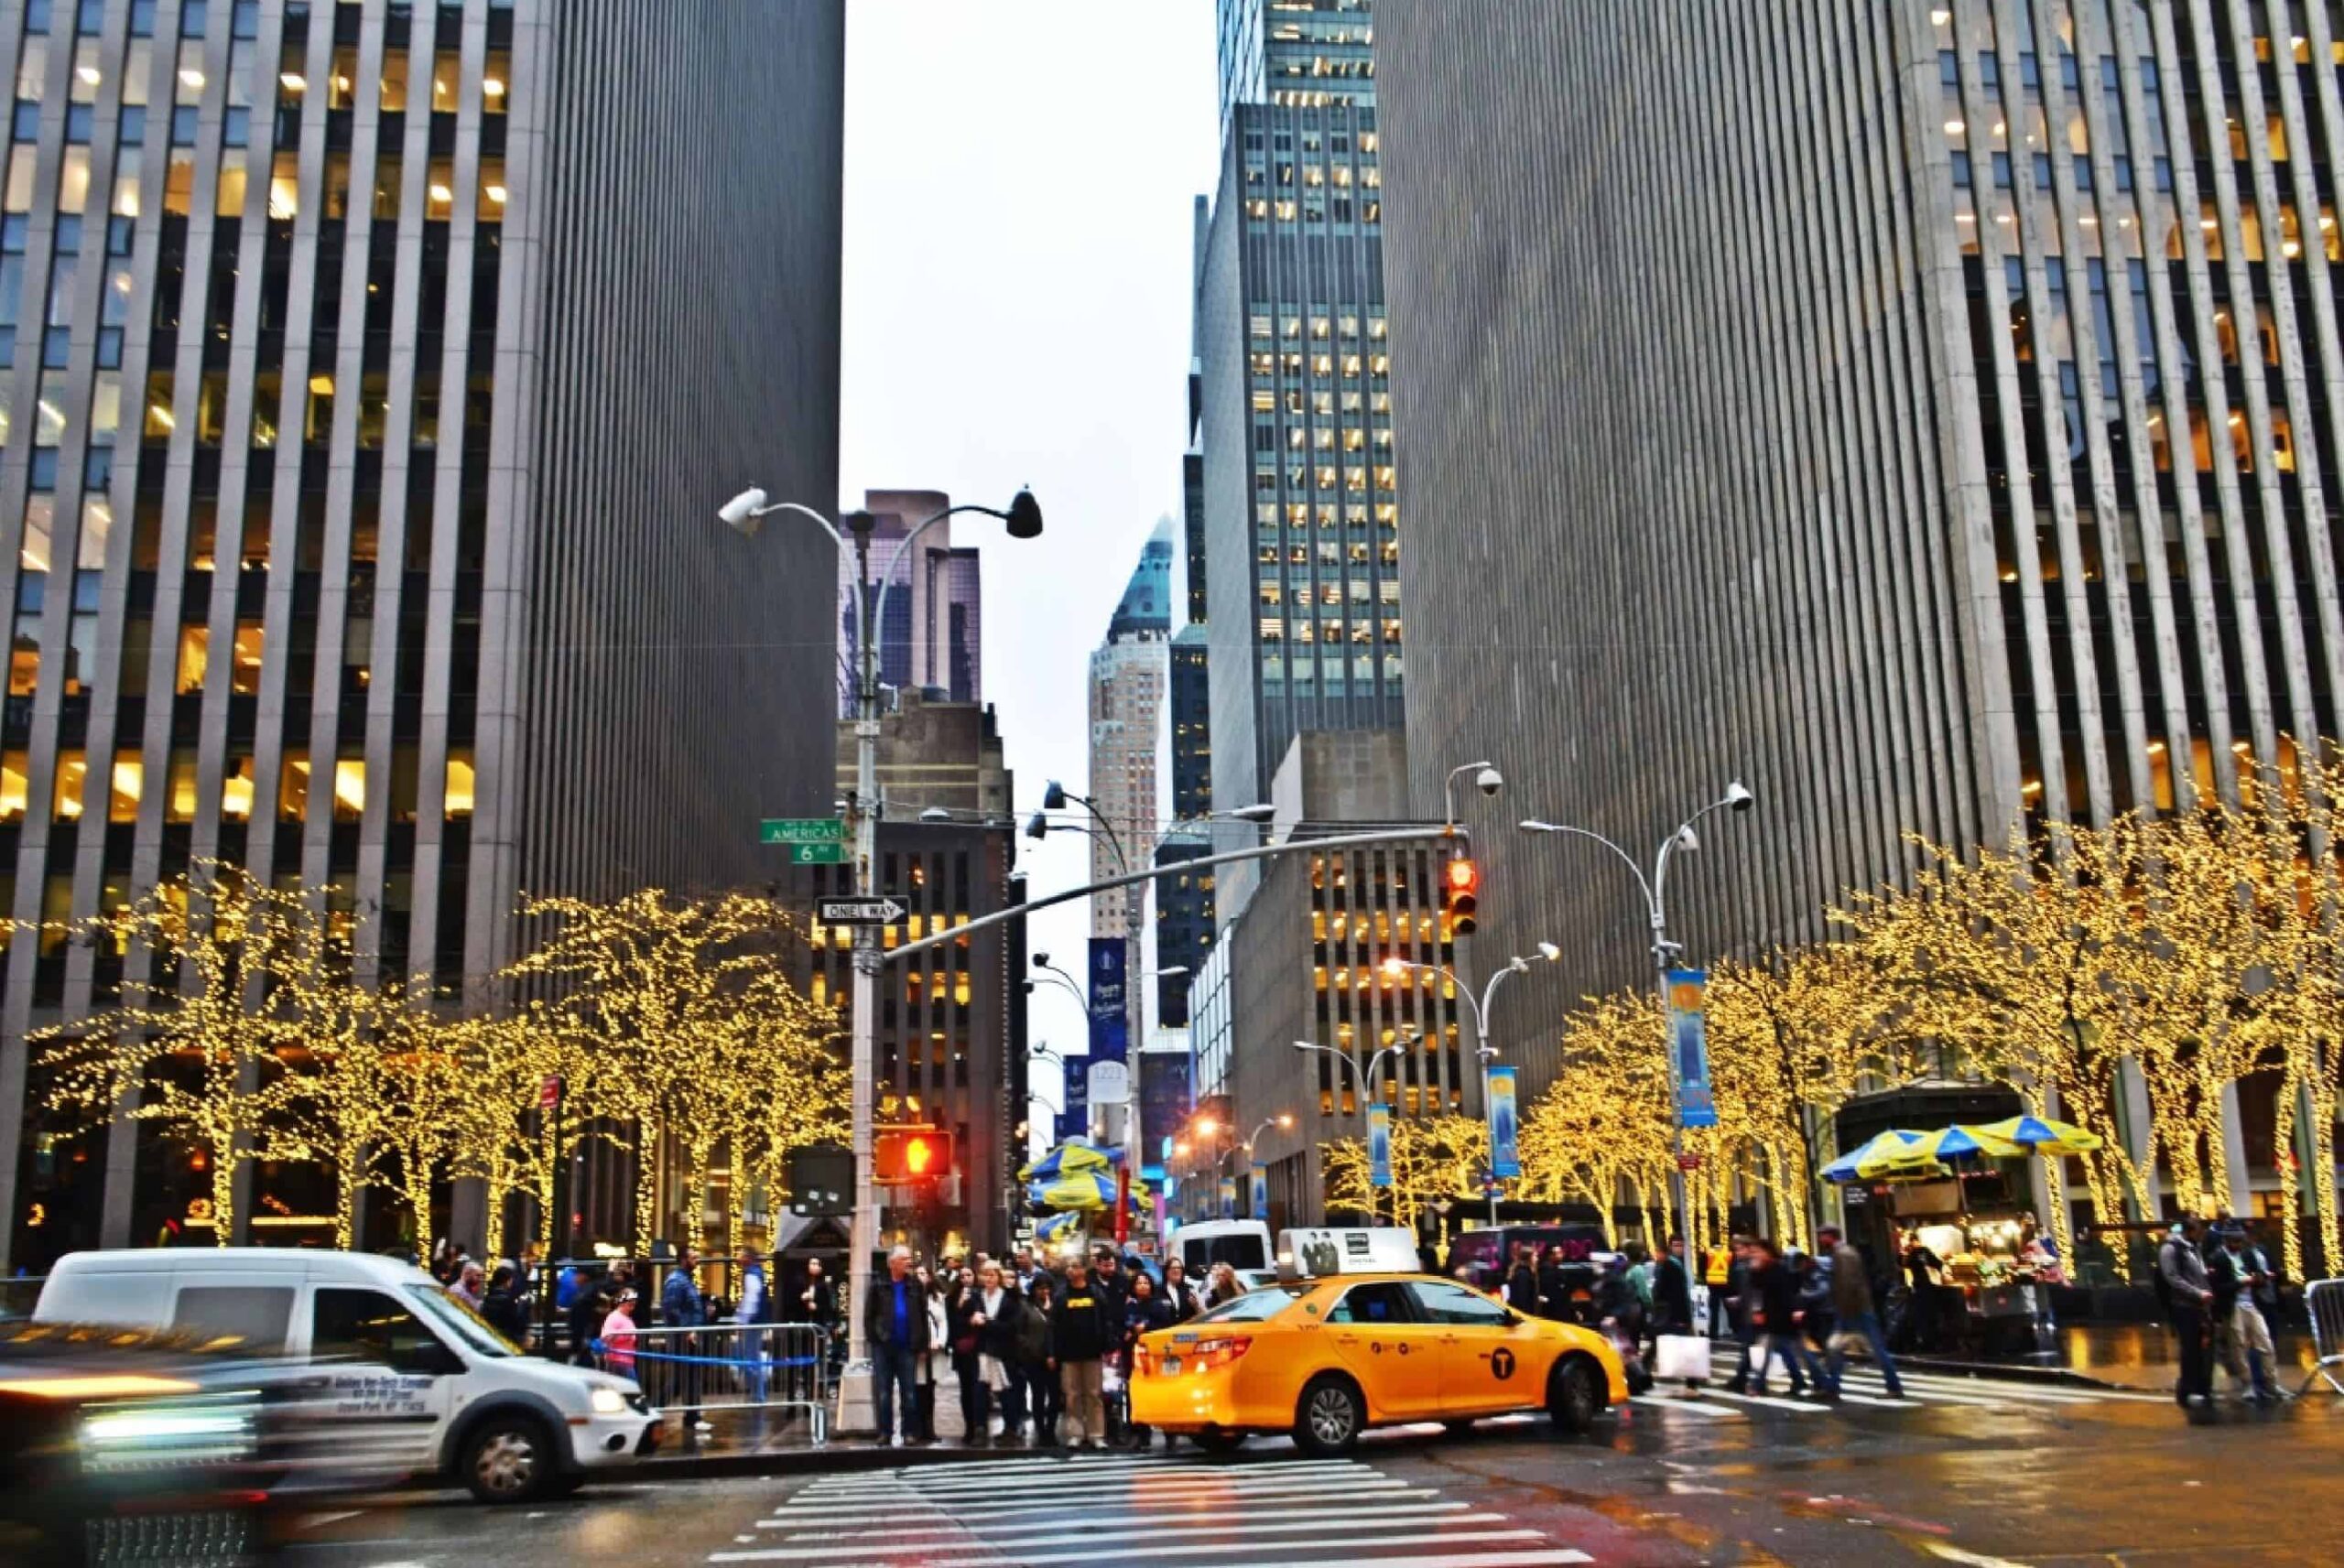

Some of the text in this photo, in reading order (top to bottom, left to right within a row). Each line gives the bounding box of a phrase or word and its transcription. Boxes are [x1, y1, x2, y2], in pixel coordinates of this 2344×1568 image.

[772, 827, 839, 840] AMERICAS
[800, 845, 813, 860] 6
[830, 905, 895, 917] ONE WAY
